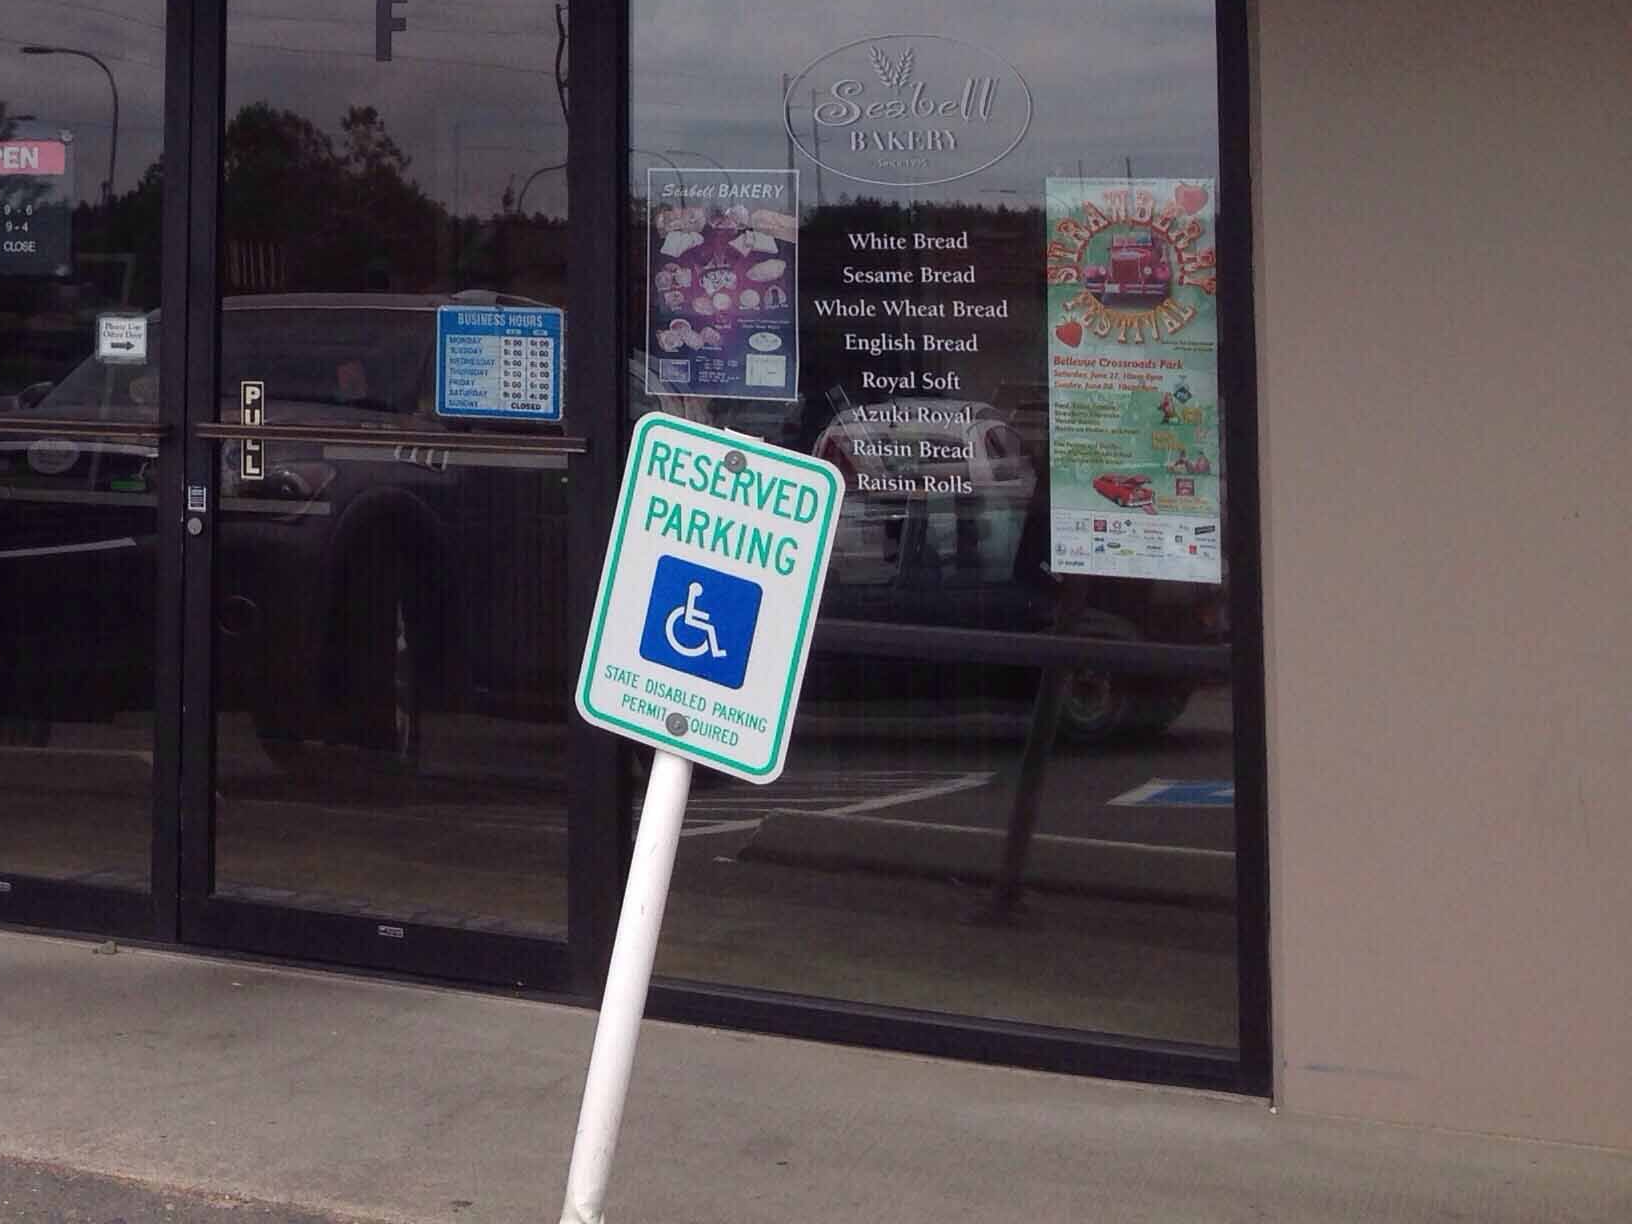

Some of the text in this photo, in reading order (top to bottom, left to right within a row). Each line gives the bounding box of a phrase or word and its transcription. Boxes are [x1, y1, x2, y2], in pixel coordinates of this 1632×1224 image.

[814, 77, 1001, 127] Seabell
[850, 128, 958, 153] BAKERY
[719, 183, 784, 199] BAKERY
[3, 240, 36, 253] CLOSE
[847, 233, 969, 250] White Bread
[842, 266, 976, 284] Sesame Bread
[814, 300, 1009, 318] Whole Wheat Bread
[457, 312, 543, 328] BUSINESS HOURS
[844, 333, 978, 352] English Bread
[862, 372, 961, 391] Royal Soft
[510, 402, 542, 410] CLOSED
[854, 407, 971, 426] Azuki Royal
[244, 386, 261, 474] PULL
[853, 441, 974, 459] Raisin Bread
[647, 441, 818, 524] RESERVED
[857, 475, 973, 493] Raisin Rolls
[644, 495, 798, 576] PARKING
[604, 665, 768, 733] STATE DISABLED PARKING
[621, 694, 739, 747] PERMIT QUIRED
